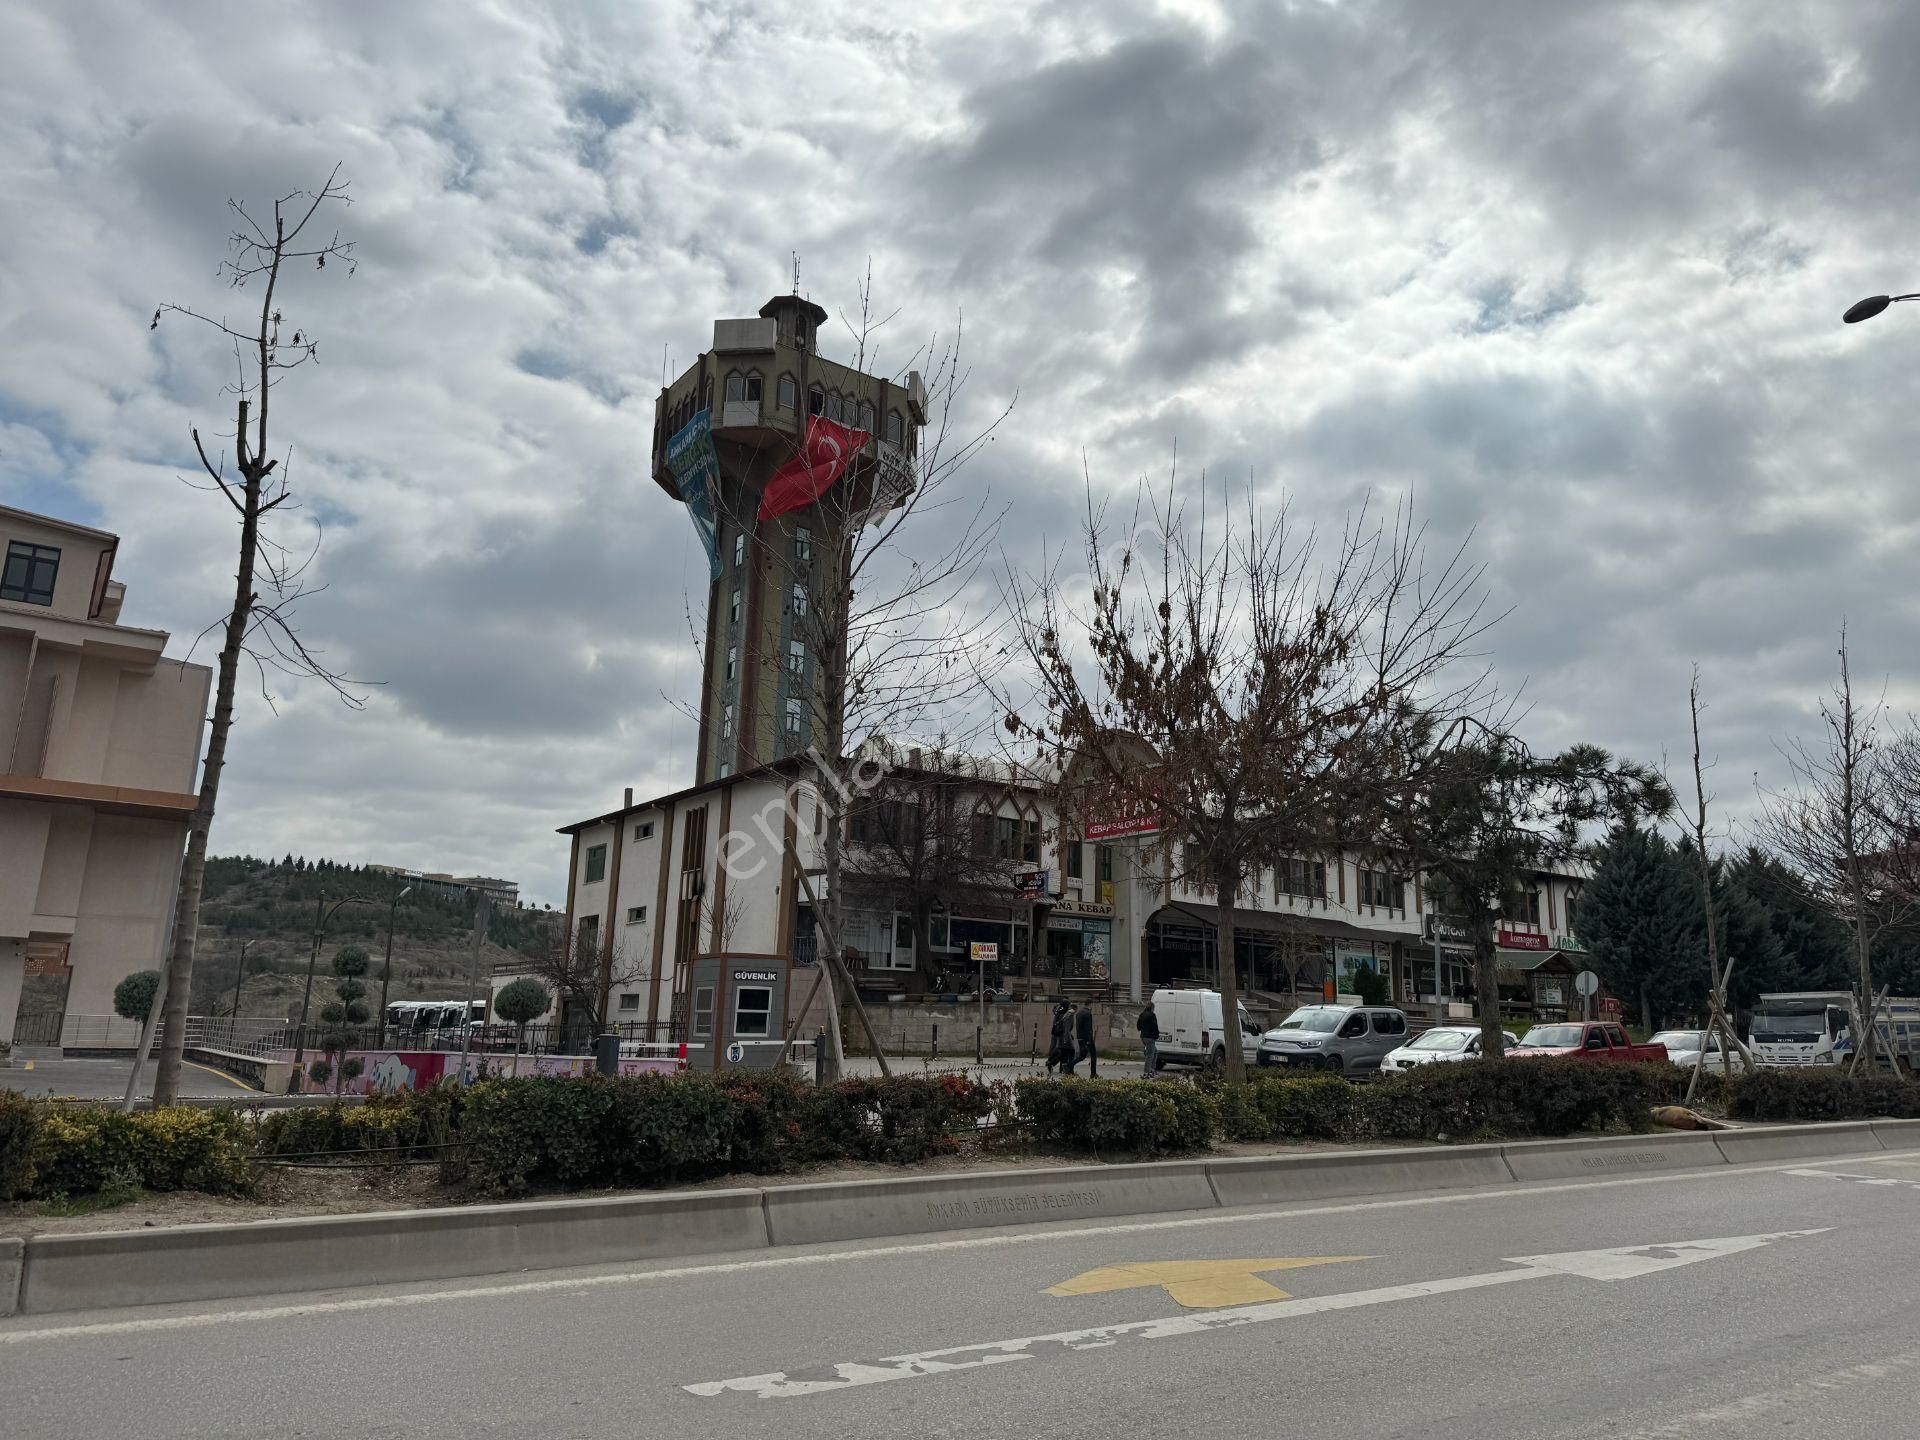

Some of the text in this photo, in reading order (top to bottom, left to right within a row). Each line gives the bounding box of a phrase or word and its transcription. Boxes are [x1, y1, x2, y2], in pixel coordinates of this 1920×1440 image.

[1049, 901, 1112, 914] ANA KEBAP
[734, 971, 777, 981] GÜVENLİK
[926, 1187, 1100, 1218] ANKARA BÜYÜKŞEHİR BELEDİYESİ
